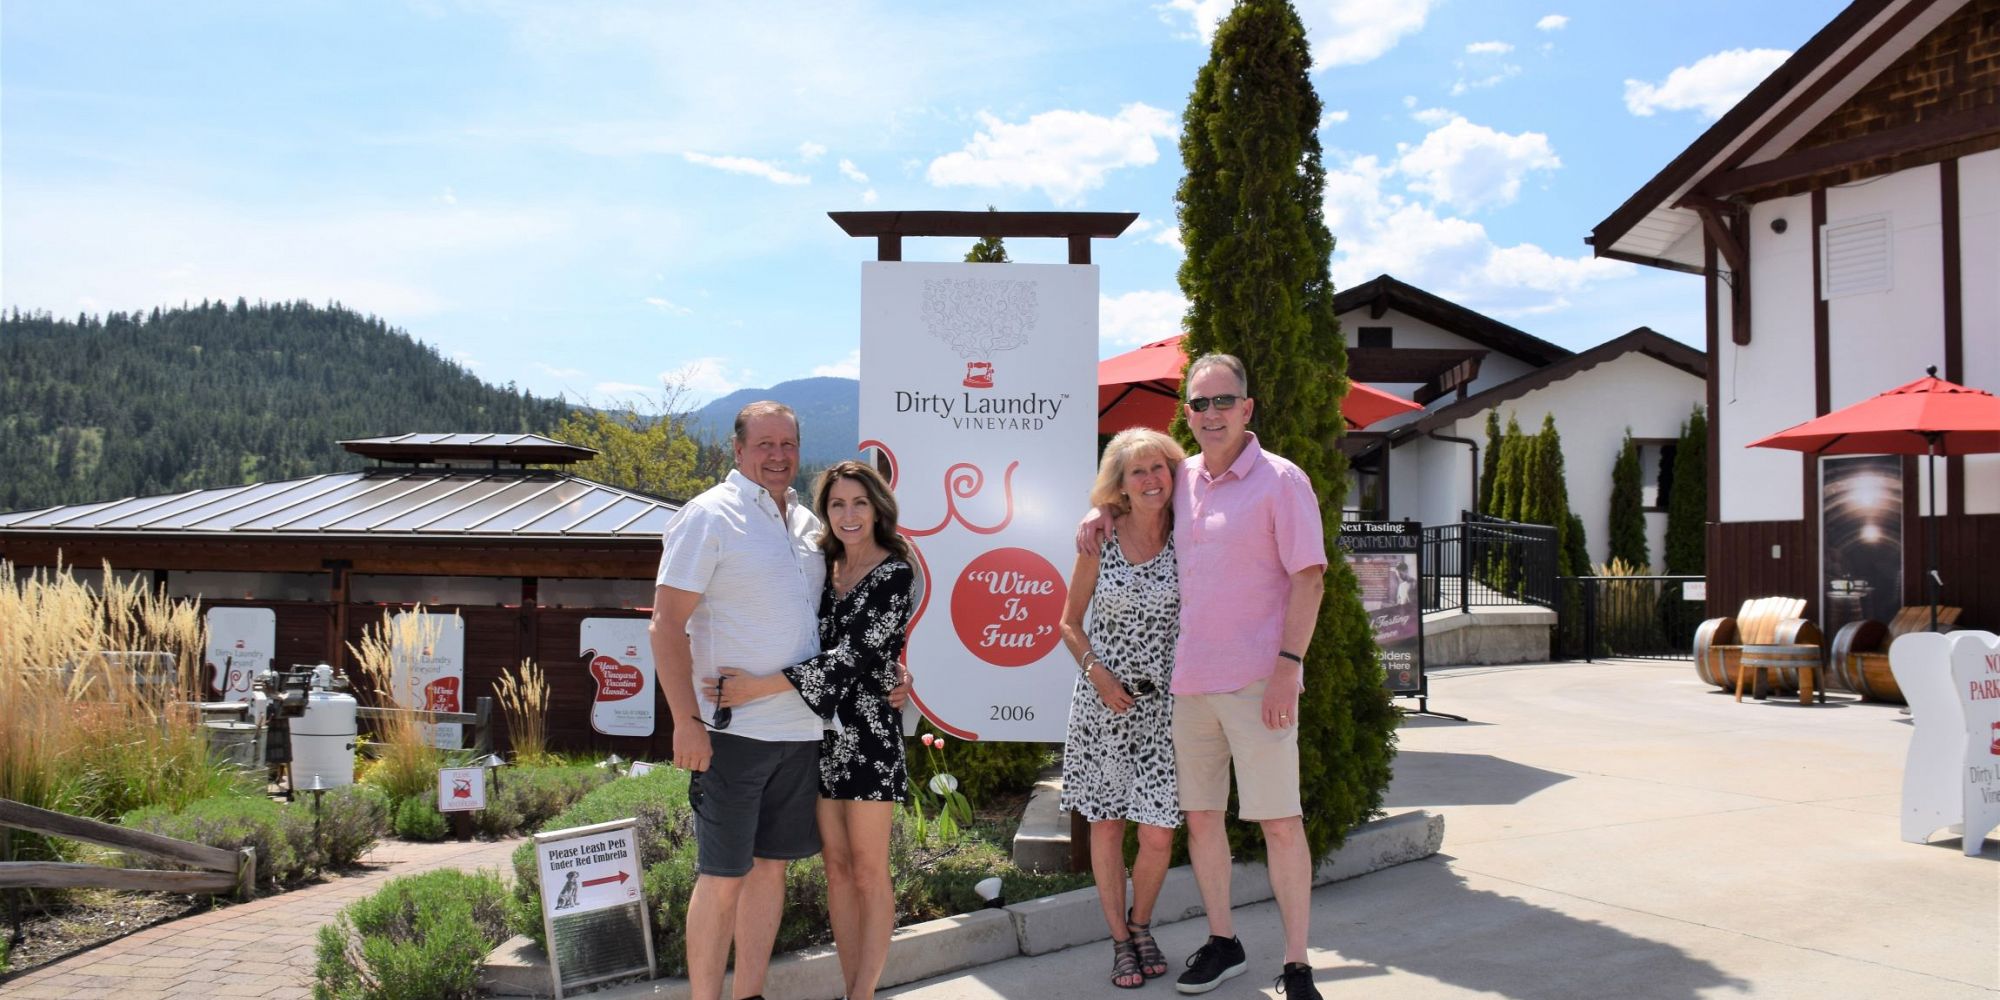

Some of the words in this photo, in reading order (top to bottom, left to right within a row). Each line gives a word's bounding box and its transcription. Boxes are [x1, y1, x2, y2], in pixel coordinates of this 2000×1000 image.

[894, 390, 955, 418] Dirty
[953, 417, 1044, 430] VINEYARD
[1339, 523, 1362, 532] Next
[1364, 522, 1405, 533] Tasting:
[1398, 535, 1418, 548] ONLY
[967, 570, 1054, 595] “Wine
[999, 598, 1029, 621] Is
[1376, 614, 1410, 628] Tasting
[979, 624, 1053, 648] Fun”
[1388, 662, 1411, 670] Here
[1985, 653, 2000, 674] NO
[989, 705, 1035, 722] 2006
[1969, 765, 1993, 786] Dirty
[548, 847, 578, 861] Please
[580, 841, 606, 855] Leash
[608, 838, 626, 851] Pets
[550, 859, 573, 871] Under
[575, 856, 592, 867] Red
[592, 849, 628, 864] Umbrella
